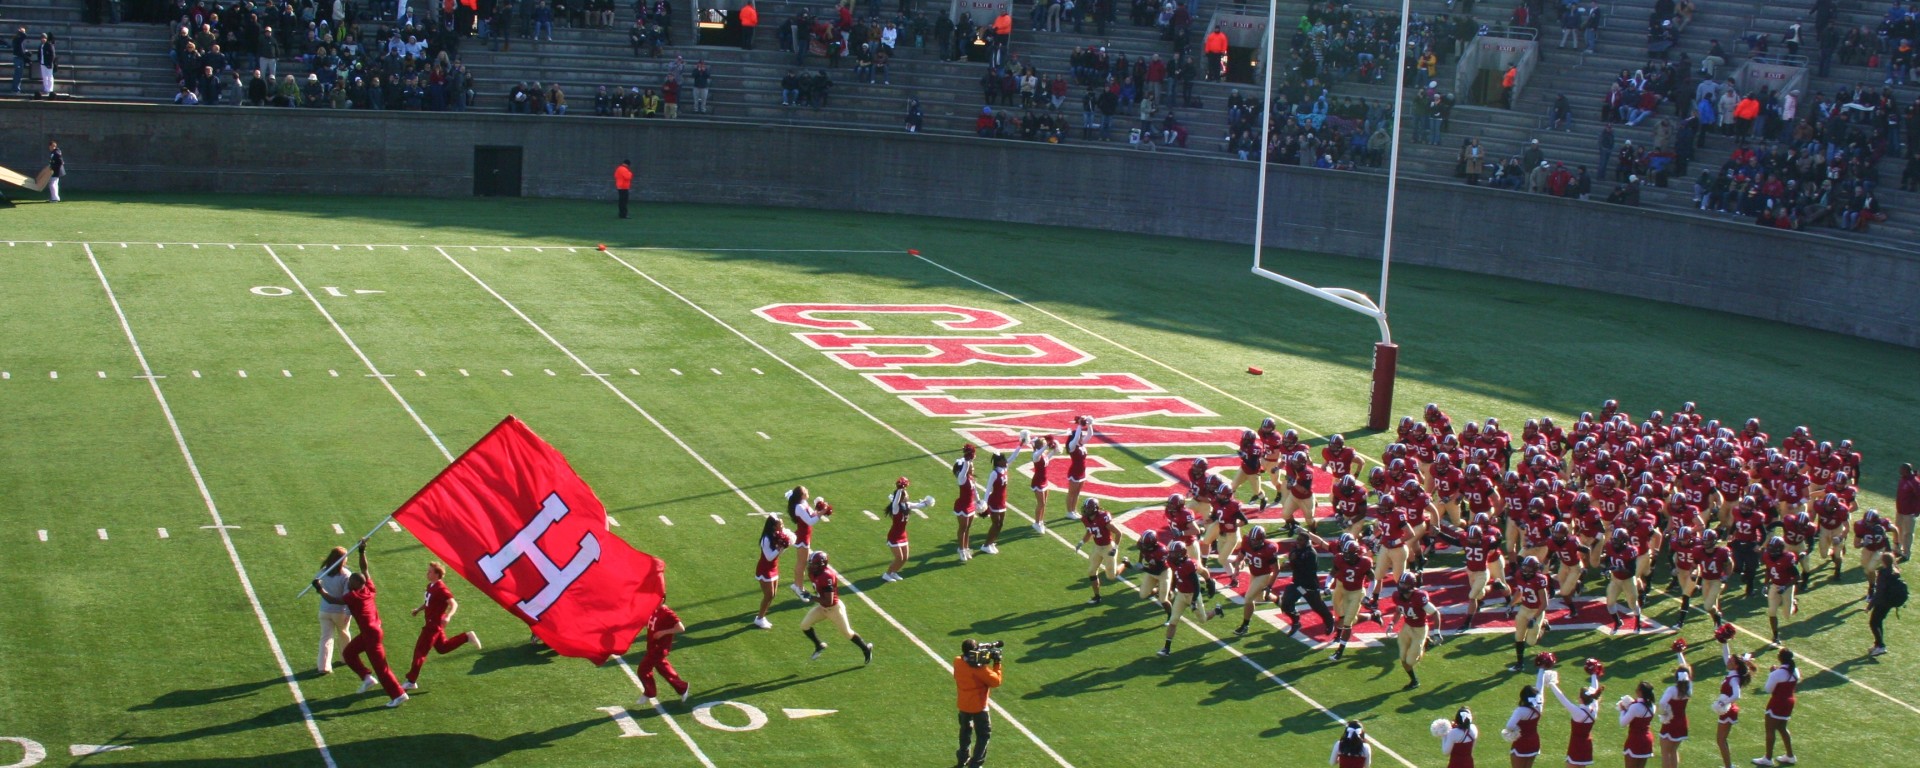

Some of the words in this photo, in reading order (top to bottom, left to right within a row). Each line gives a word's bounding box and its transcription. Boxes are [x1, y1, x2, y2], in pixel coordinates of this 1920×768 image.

[1789, 449, 1804, 462] 81
[1328, 461, 1345, 474] 92
[1813, 466, 1831, 479] 78
[1721, 480, 1738, 493] 56
[1464, 492, 1483, 504] 79
[1685, 488, 1702, 503] 63
[1216, 510, 1225, 524] 2
[476, 490, 602, 622] H
[1245, 551, 1262, 569] 59
[1465, 546, 1484, 562] 25
[1701, 560, 1718, 574] 14
[1770, 566, 1780, 580] 4
[1345, 569, 1355, 582] 2
[597, 700, 769, 738] 10
